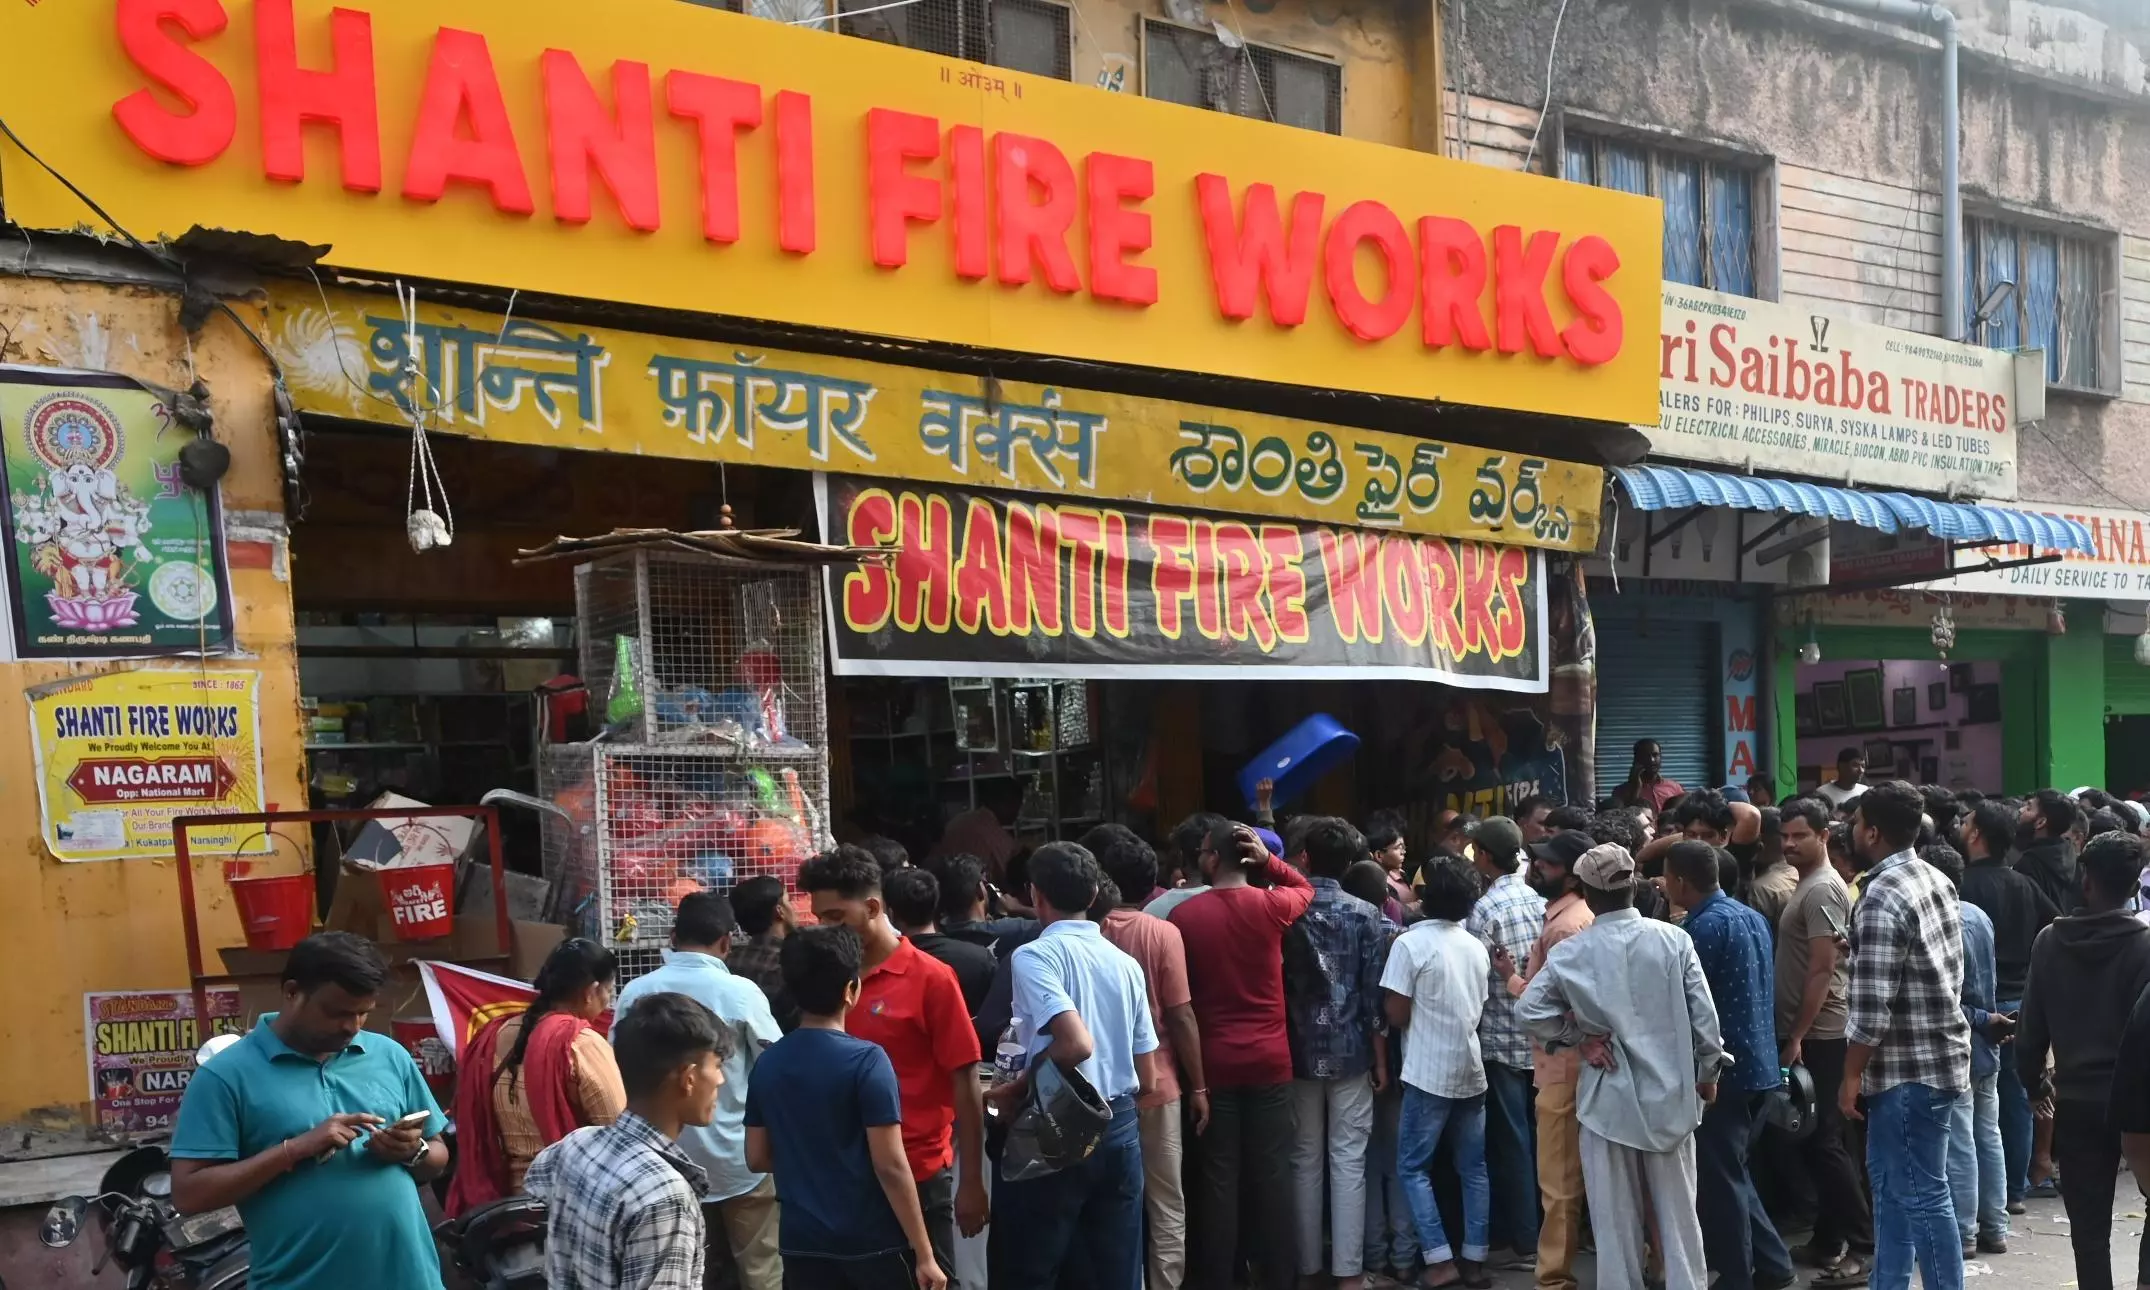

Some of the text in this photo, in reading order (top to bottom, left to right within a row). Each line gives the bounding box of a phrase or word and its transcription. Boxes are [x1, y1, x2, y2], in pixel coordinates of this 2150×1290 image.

[112, 0, 1624, 365] SHANTI FIRE WORKS
[1660, 319, 2006, 434] ri Saibaba TRADERS
[1675, 416, 1739, 441] ELECTRICAL
[1888, 447, 1910, 464] ABRO
[1911, 453, 1928, 467] PVC
[1931, 455, 1982, 473] INSULATION
[1841, 419, 1877, 440] SYSKA
[1881, 424, 1918, 445] LAMPS
[1921, 431, 1929, 446] &
[1932, 432, 1953, 449] LED
[1957, 436, 1990, 455] TUBES
[1170, 420, 1347, 505] శాంతి
[844, 487, 1528, 664] SHANTI FIRE WORKS
[2011, 566, 2150, 590] DAILY SERVICE TO TA
[54, 705, 238, 739] SHANTI FIRE WORKS
[88, 742, 102, 752] We
[104, 742, 138, 754] Proudly
[141, 742, 180, 752] Welcome
[183, 742, 199, 752] You
[1726, 695, 1758, 777] MA
[93, 764, 213, 786] NAGARAM
[141, 788, 181, 798] National
[183, 787, 205, 797] Mart
[149, 820, 173, 831] Branc
[136, 838, 175, 850] Kukatpa
[391, 899, 448, 926] FIRE
[96, 1020, 176, 1057] SHANTI
[180, 1017, 225, 1051] FIE
[128, 1056, 145, 1066] We
[149, 1054, 190, 1066] Proudly
[146, 1071, 192, 1090] NAR
[112, 1099, 132, 1108] One
[134, 1098, 156, 1108] Stop
[145, 1114, 170, 1128] 94
